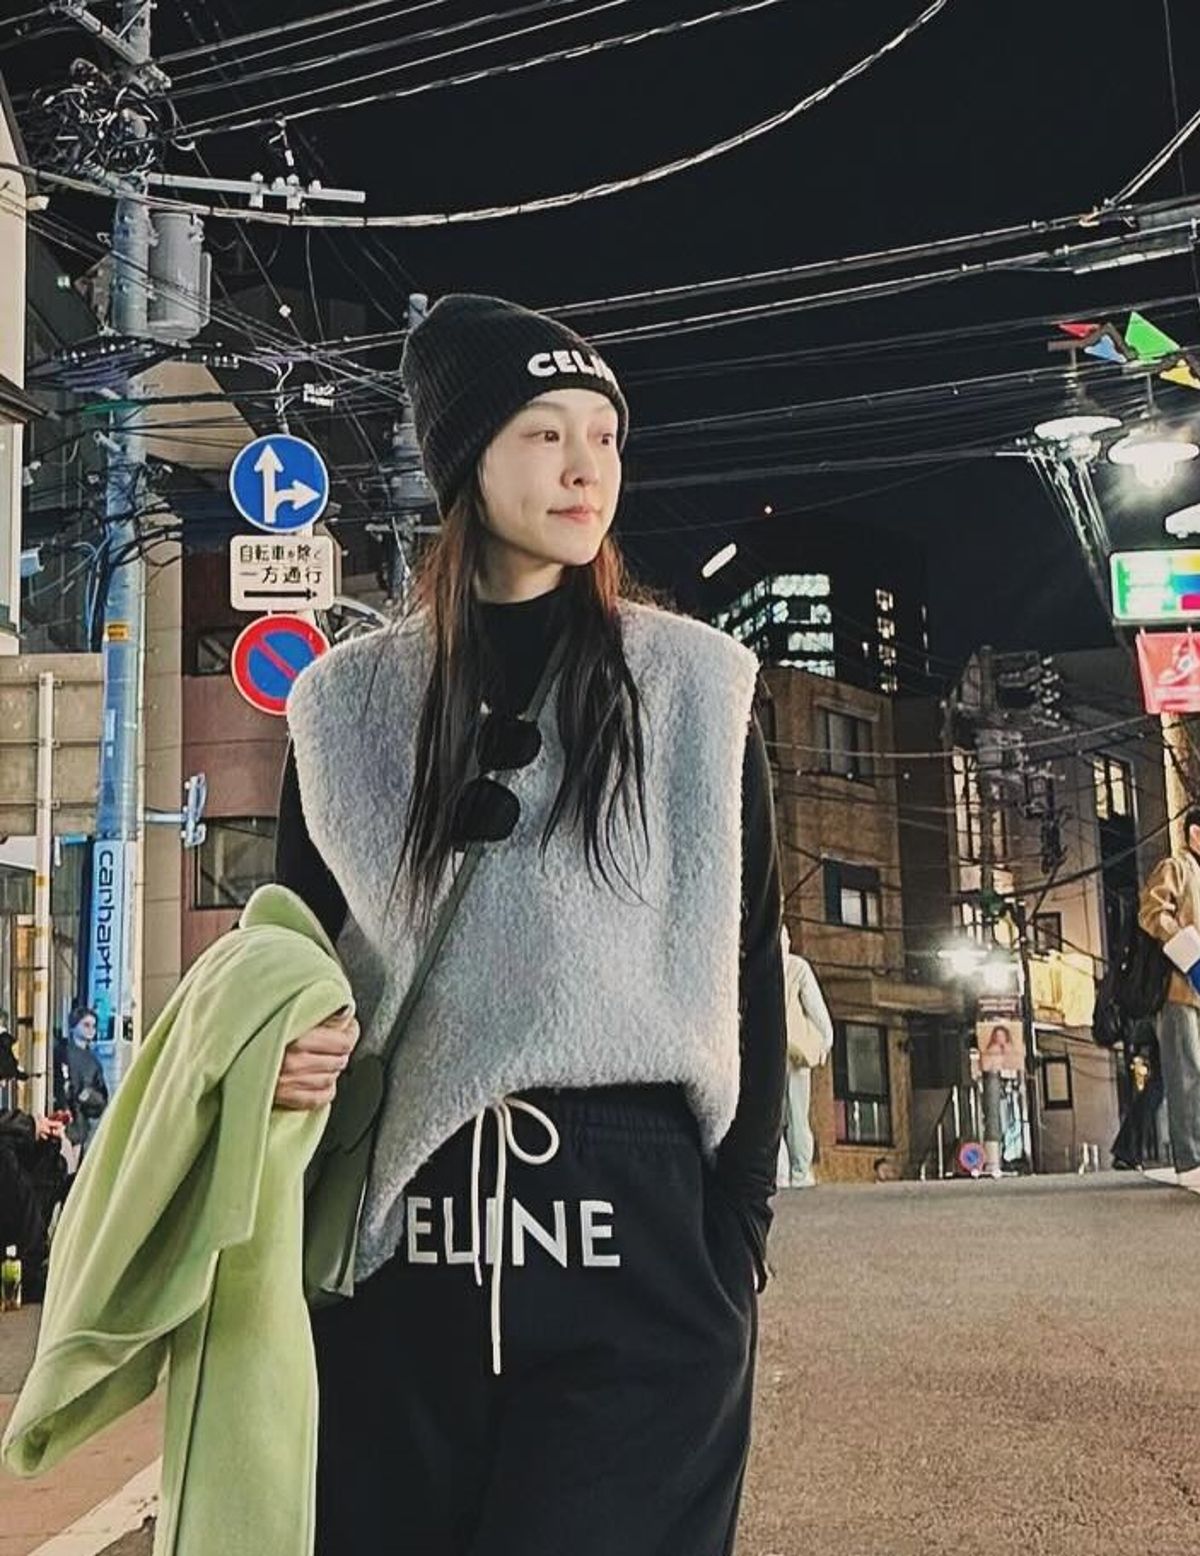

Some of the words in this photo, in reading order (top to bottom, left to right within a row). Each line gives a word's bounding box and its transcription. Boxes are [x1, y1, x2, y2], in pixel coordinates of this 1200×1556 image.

[240, 543, 321, 563] 自転車を除く
[239, 565, 322, 584] 一方通行
